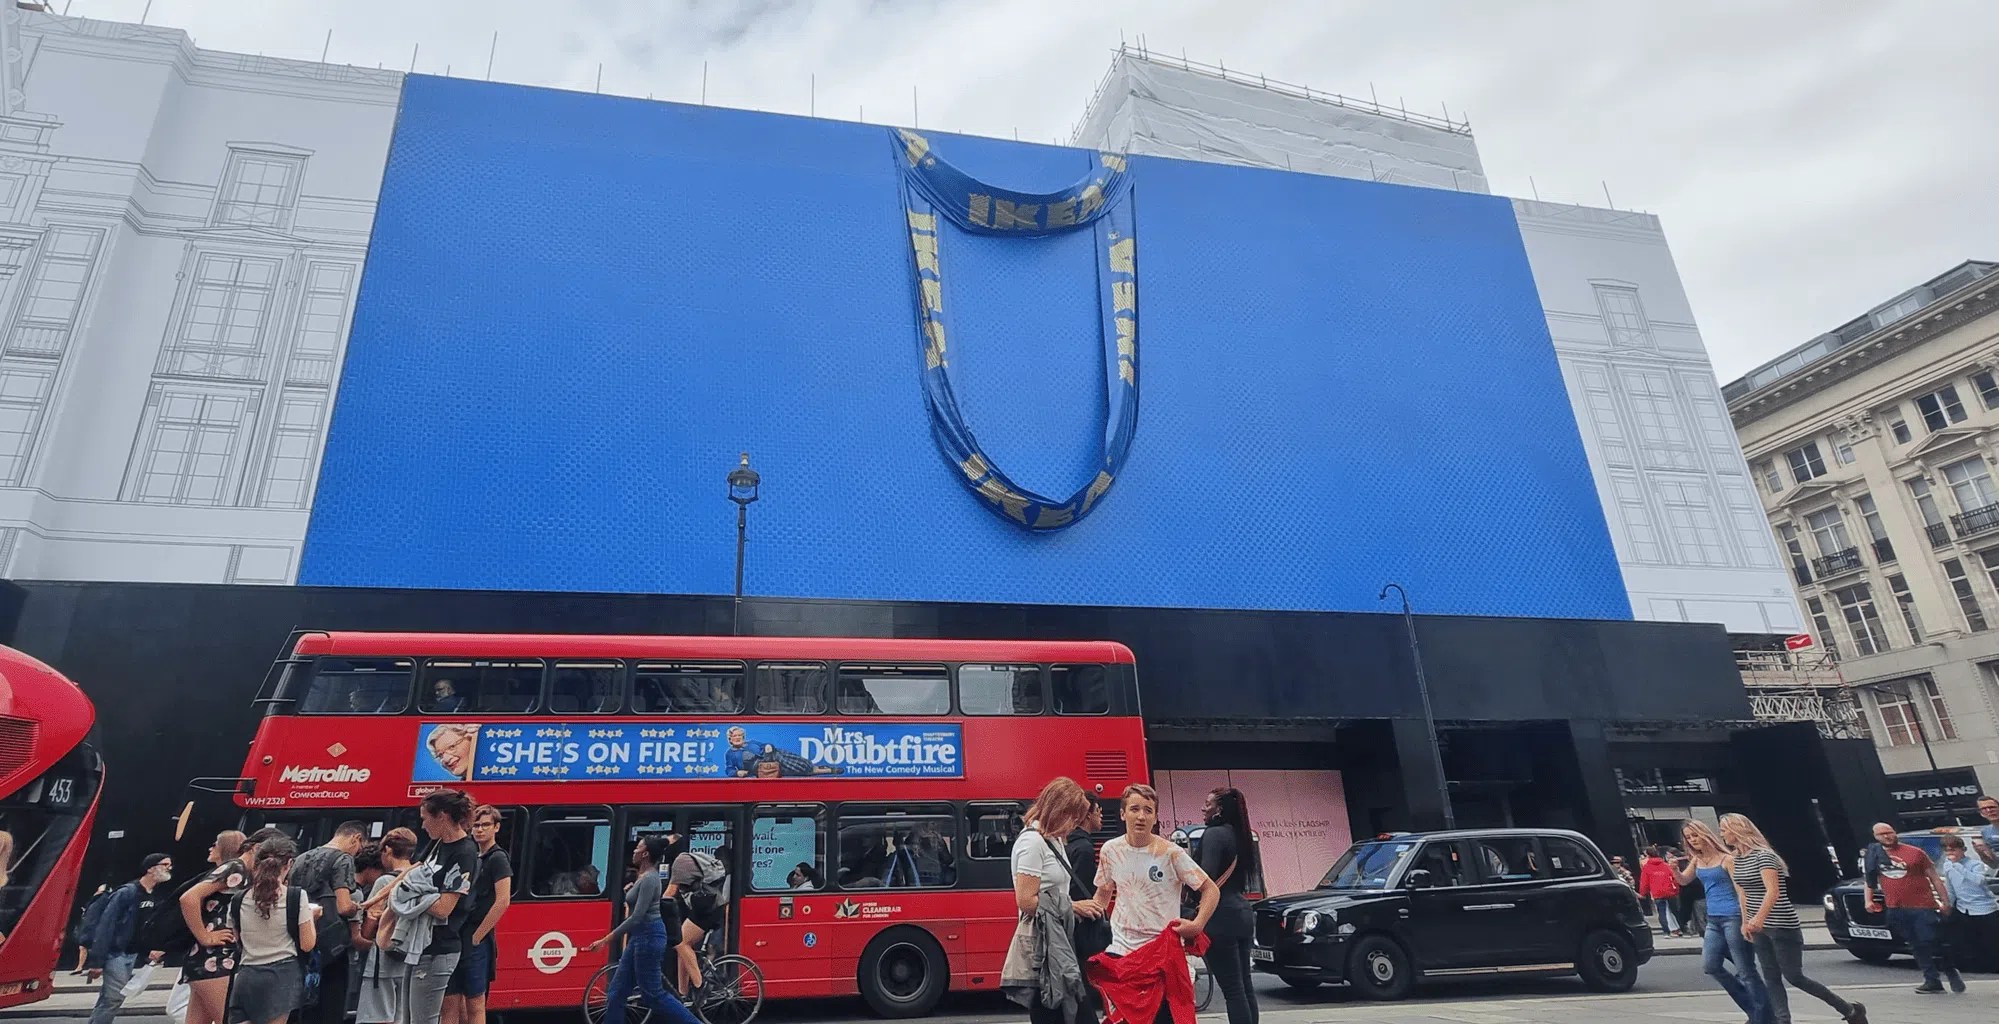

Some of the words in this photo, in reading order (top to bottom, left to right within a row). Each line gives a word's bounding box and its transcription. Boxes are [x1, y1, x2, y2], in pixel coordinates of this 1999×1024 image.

[968, 185, 1106, 230] IKEA
[823, 727, 866, 744] Mrs.
[489, 742, 579, 763] ‘SHE’S
[588, 742, 630, 763] ON
[639, 742, 714, 763] FIRE!’
[799, 735, 956, 765] Doubtfire
[279, 765, 371, 783] Metroline
[846, 765, 862, 773] The
[865, 765, 884, 773] New
[885, 765, 921, 775] Comedy
[923, 765, 955, 773] Musical
[49, 778, 73, 803] 453
[245, 797, 265, 805] VWH
[266, 797, 286, 805] 2328
[1298, 820, 1330, 828] FLAGSHIP
[1263, 830, 1284, 838] RETAIL
